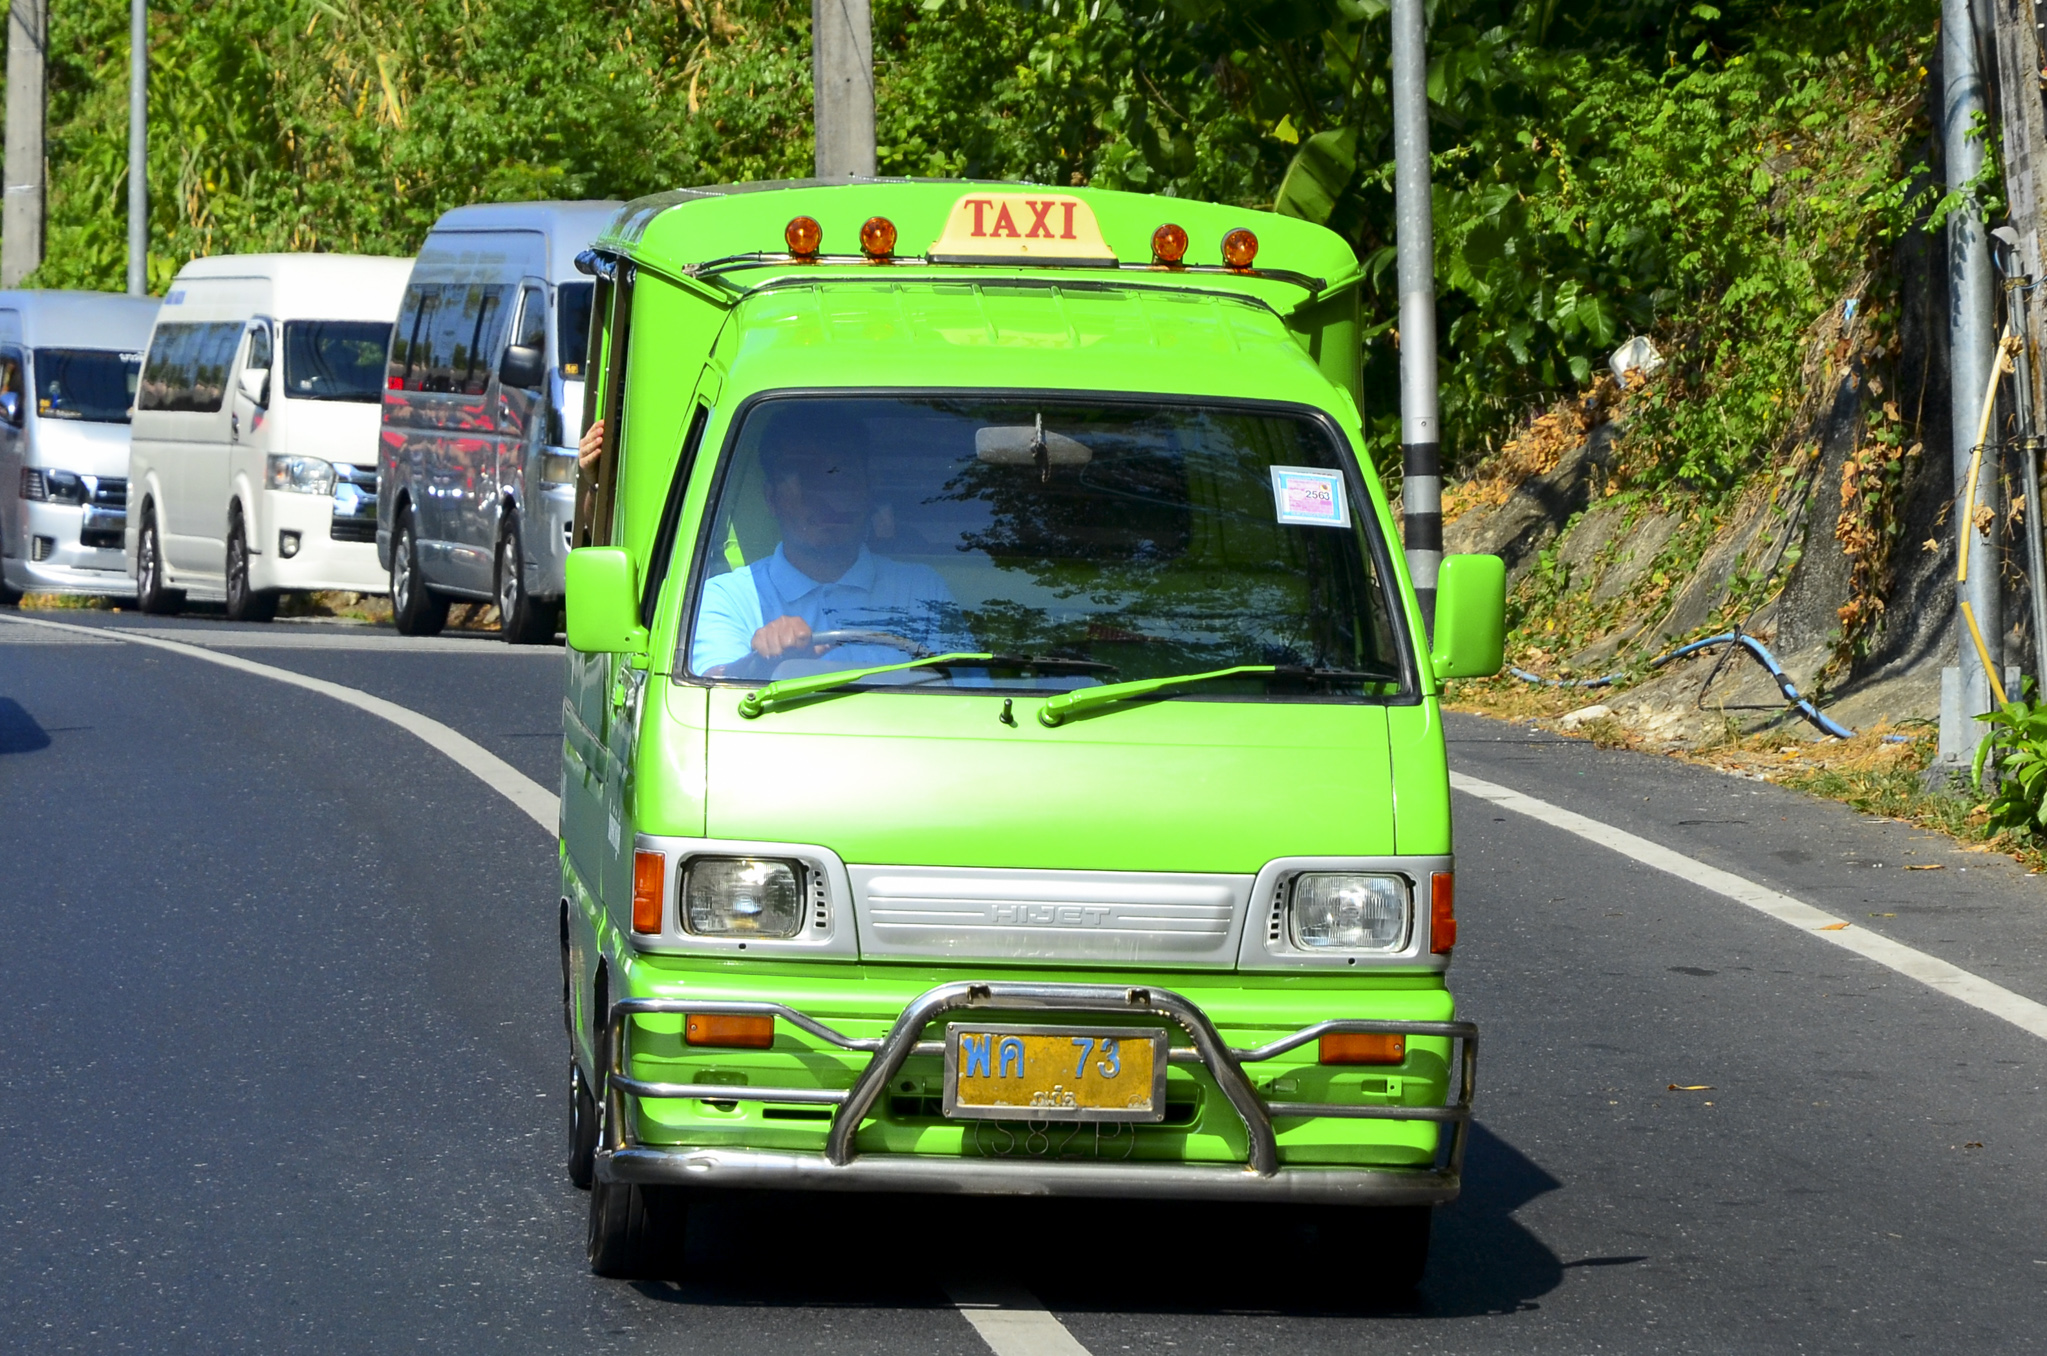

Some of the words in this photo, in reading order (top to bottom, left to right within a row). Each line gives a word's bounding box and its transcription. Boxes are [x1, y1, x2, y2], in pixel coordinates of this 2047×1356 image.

[964, 200, 1077, 239] TAXI
[1305, 490, 1330, 500] 2563
[991, 904, 1110, 926] HIJET
[1071, 1037, 1120, 1079] 73
[1030, 1085, 1077, 1107] ภเก็ต
